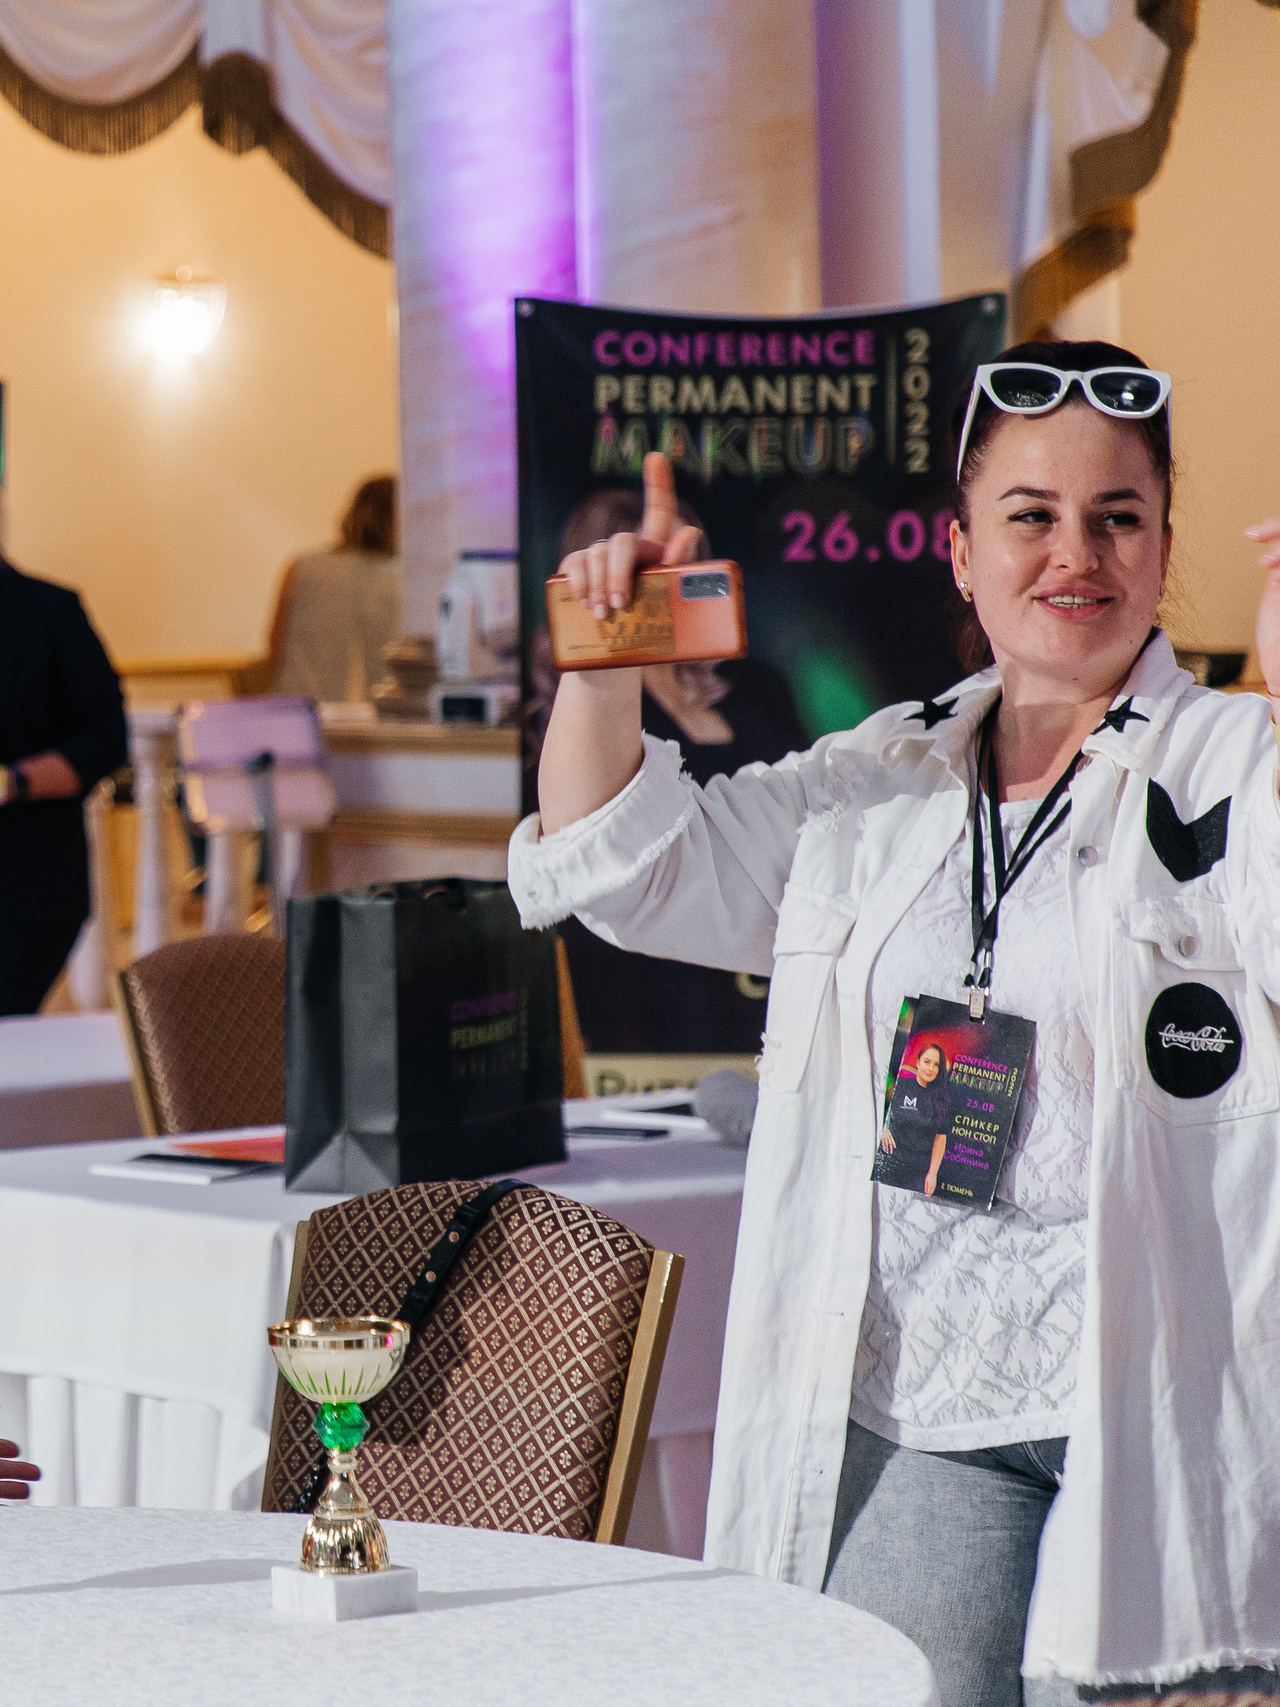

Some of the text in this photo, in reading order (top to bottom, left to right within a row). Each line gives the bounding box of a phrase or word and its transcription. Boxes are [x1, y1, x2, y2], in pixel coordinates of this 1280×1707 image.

[593, 329, 875, 366] CONFERENCE
[593, 373, 877, 414] PERMANENT
[902, 327, 931, 474] 2022
[590, 416, 876, 477] MAKEUP
[952, 1062, 1007, 1082] PERMANENT
[954, 1053, 1009, 1073] CONFERENCE
[949, 1070, 1004, 1095] MAKEUP
[1008, 1067, 1019, 1097] 2022
[966, 1098, 995, 1113] 25.08
[951, 1125, 997, 1144] НОН СТОП
[954, 1115, 1000, 1133] СПИКЕР
[954, 1142, 984, 1157] Ирина
